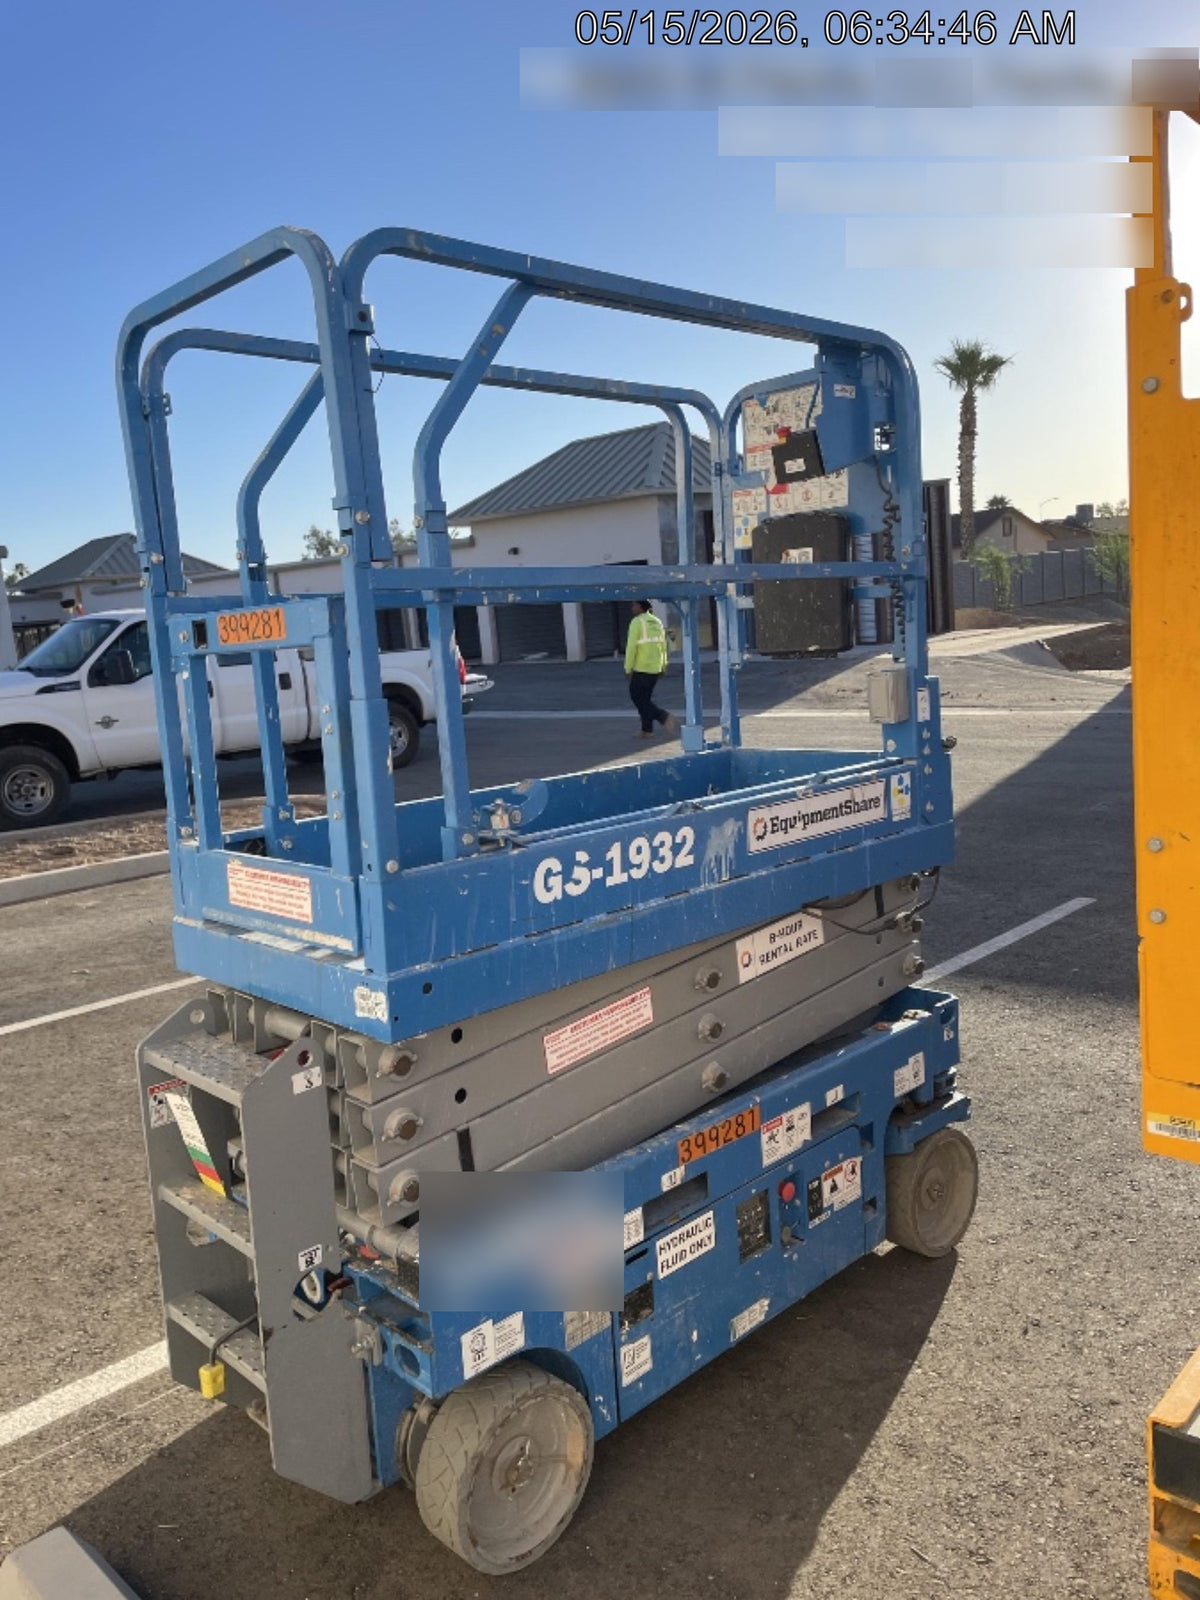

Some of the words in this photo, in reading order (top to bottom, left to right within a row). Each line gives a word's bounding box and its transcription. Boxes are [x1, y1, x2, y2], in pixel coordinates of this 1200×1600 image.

[218, 608, 282, 643] 399281
[769, 795, 881, 834] EquipmentShare
[533, 825, 695, 904] GS-1932
[759, 942, 793, 965] RENTAL
[795, 929, 819, 949] RATE
[680, 1109, 755, 1163] 399281
[658, 1217, 712, 1256] HYDRAULIC
[660, 1249, 687, 1273] FLUID
[689, 1233, 713, 1254] ONLY
